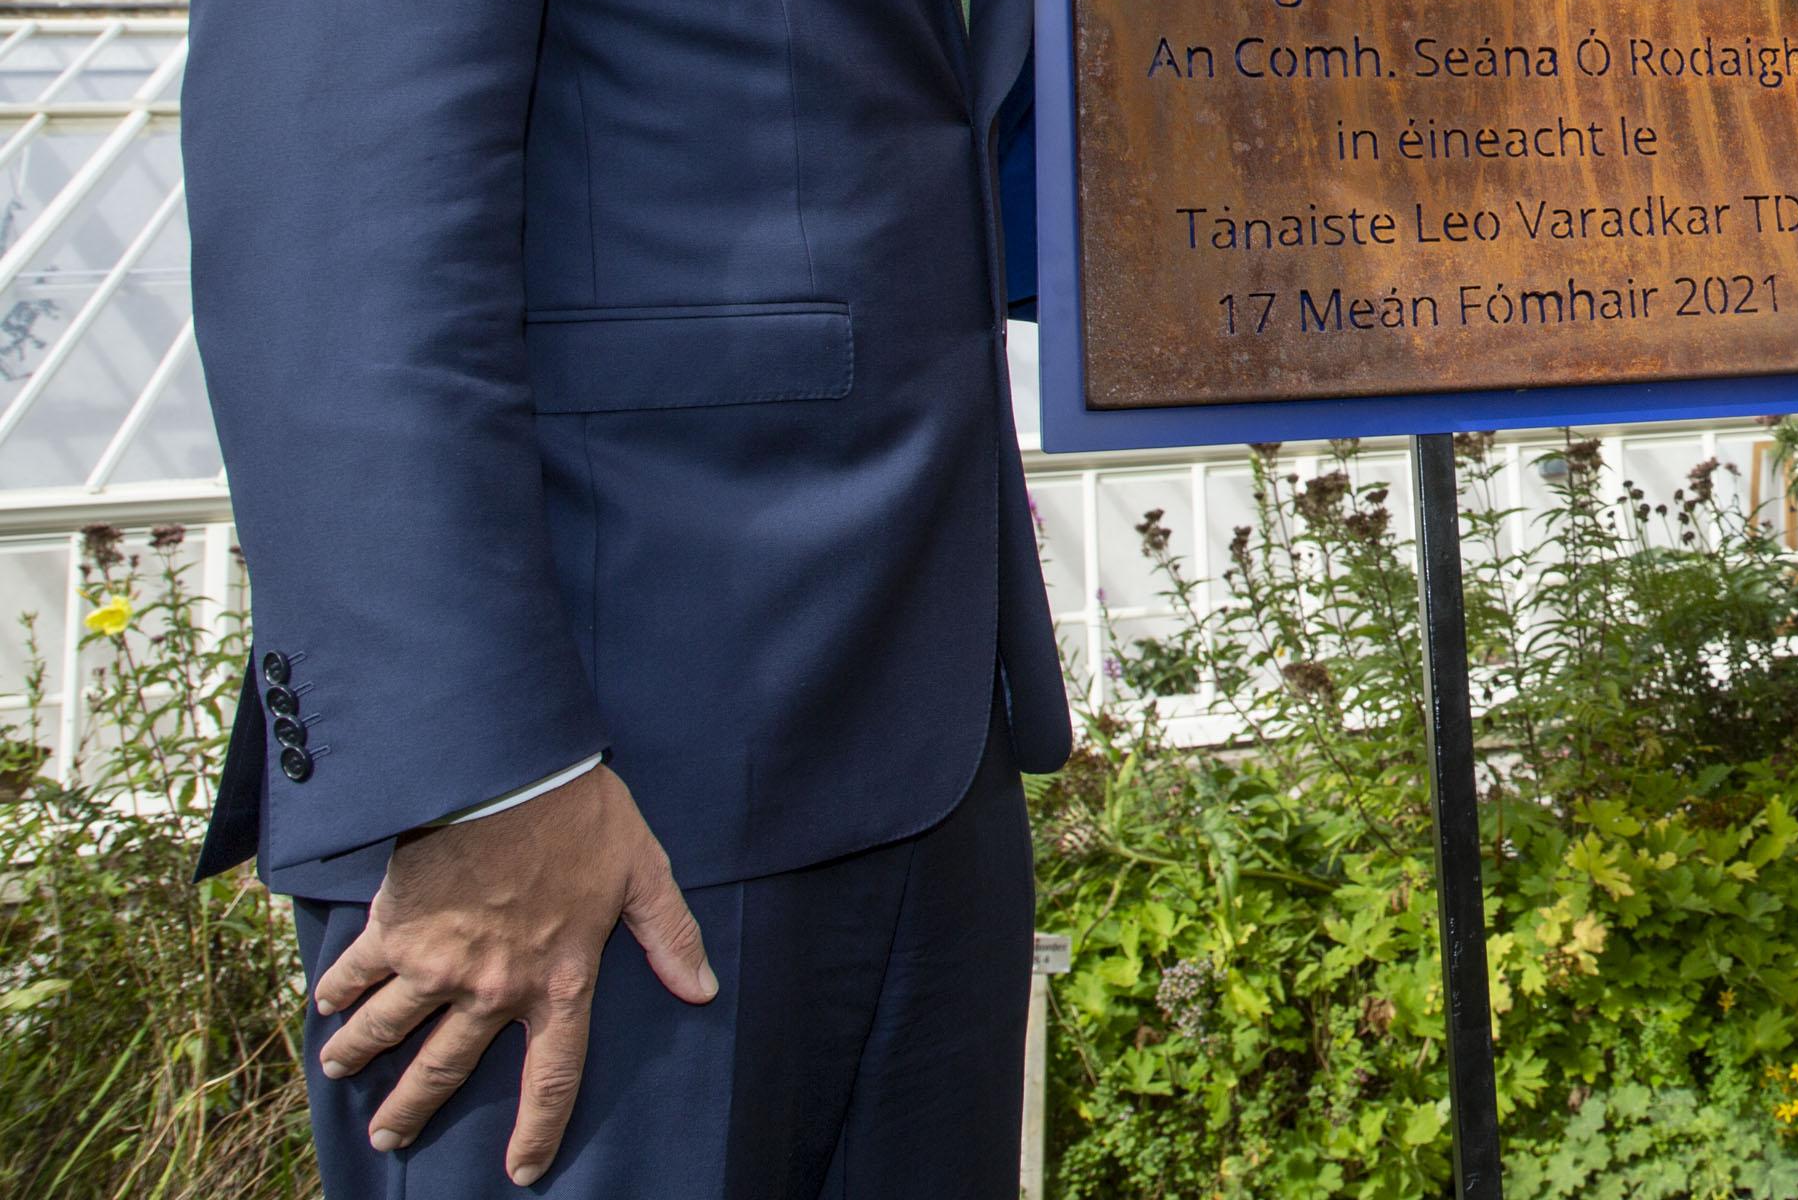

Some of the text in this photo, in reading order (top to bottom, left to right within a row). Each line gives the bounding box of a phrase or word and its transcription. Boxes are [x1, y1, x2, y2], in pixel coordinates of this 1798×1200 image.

[1149, 37, 1215, 80] An
[1234, 36, 1396, 79] Comh.
[1415, 36, 1559, 78] Seána
[1576, 28, 1611, 77] Ó
[1336, 116, 1659, 161] in éineacht le
[1176, 203, 1396, 250] Tánaiste
[1415, 202, 1501, 244] Leo
[1515, 194, 1731, 240] Varadkar
[1219, 273, 1781, 336] 17 Meán Fómhair 2021
